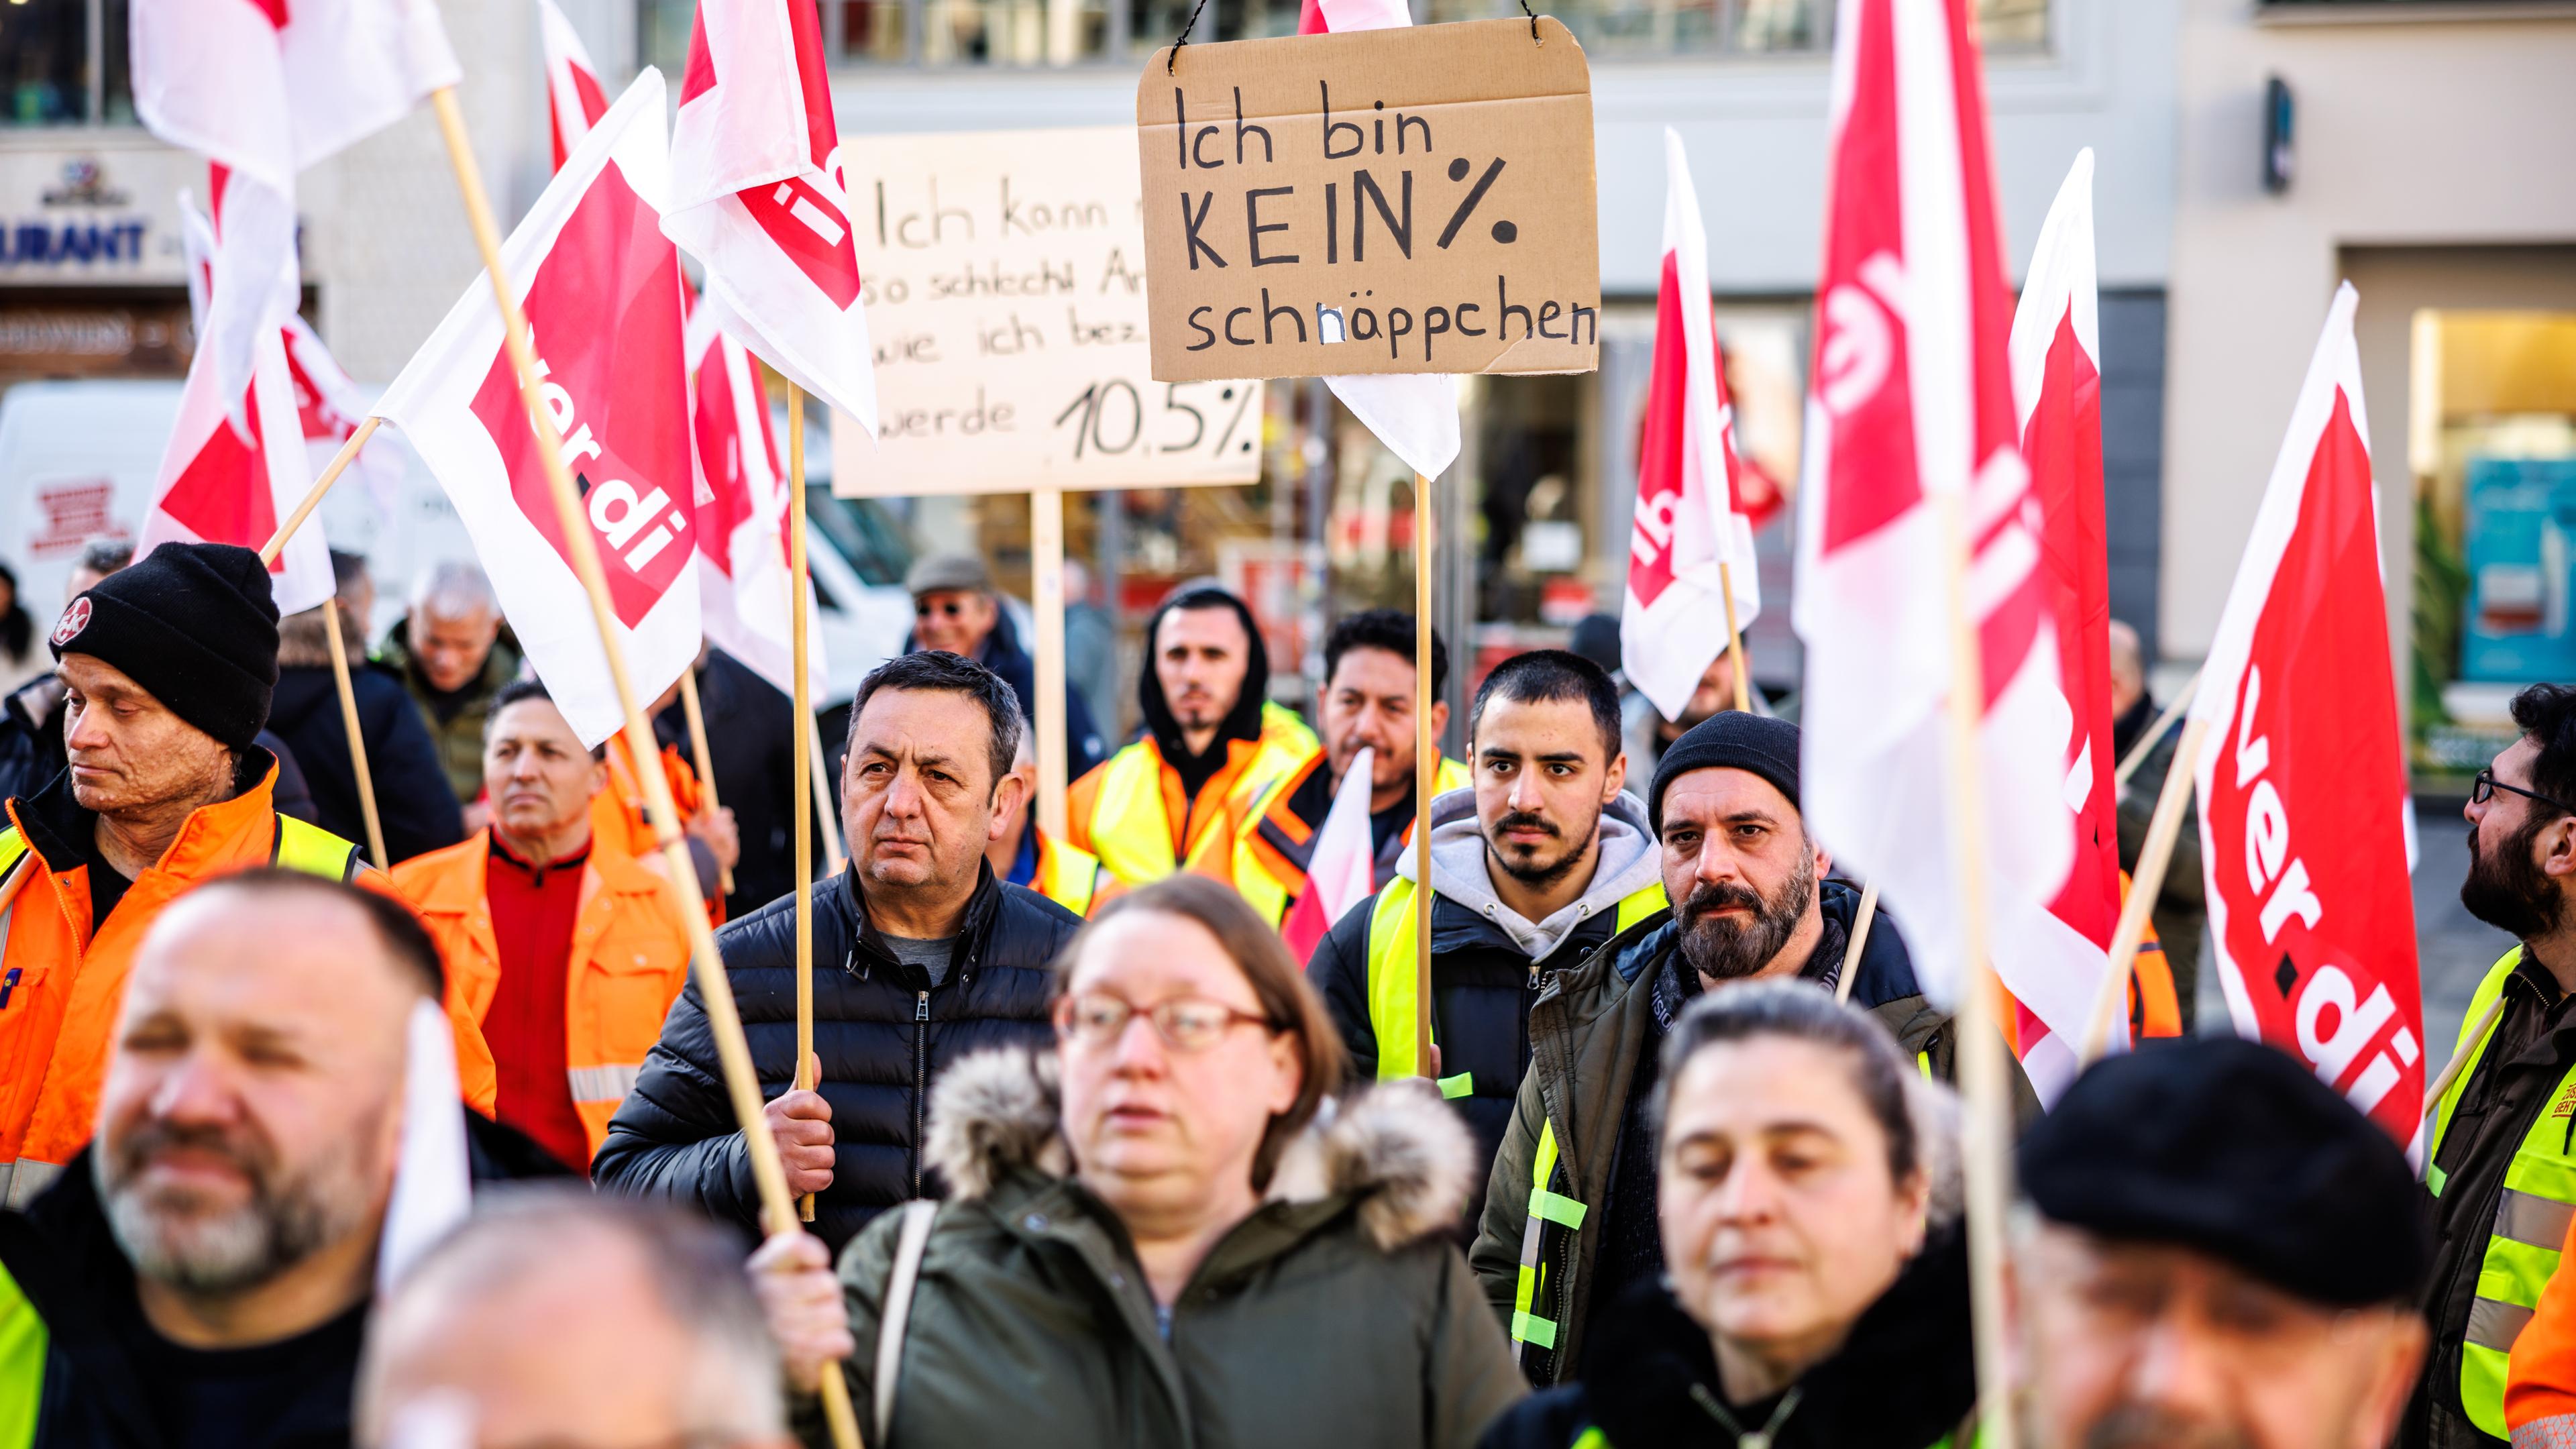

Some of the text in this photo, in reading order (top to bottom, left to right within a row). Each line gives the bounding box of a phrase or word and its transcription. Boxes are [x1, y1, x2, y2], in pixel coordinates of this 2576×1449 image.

[1175, 79, 1432, 169] Ich bin
[875, 176, 975, 248] Ich
[1002, 176, 1108, 236] kann
[979, 312, 1044, 356] ich
[1186, 274, 1595, 362] schnäppchen
